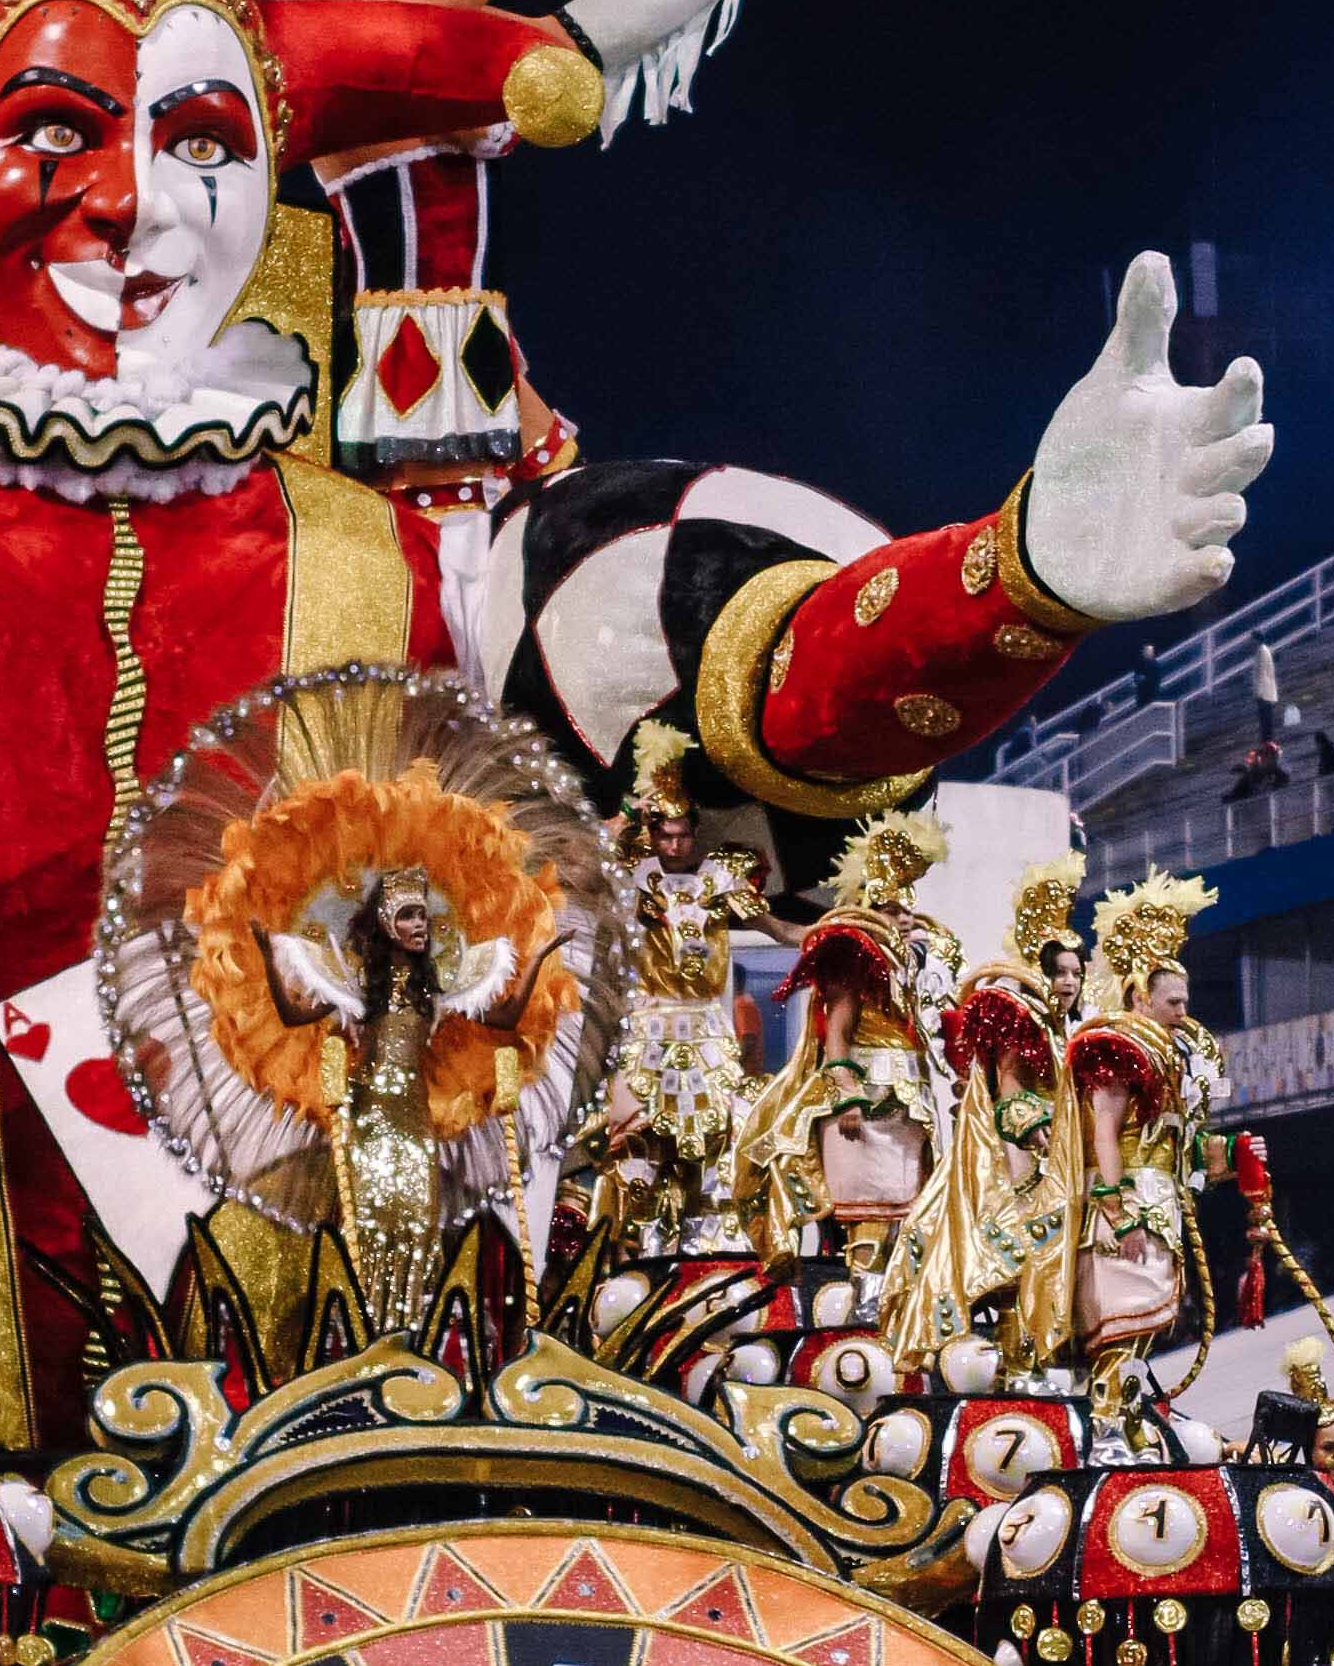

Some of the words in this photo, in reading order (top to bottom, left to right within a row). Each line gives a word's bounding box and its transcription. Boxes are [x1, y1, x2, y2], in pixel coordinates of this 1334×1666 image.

[4, 1002, 32, 1035] A
[835, 1349, 870, 1391] 0
[995, 1430, 1026, 1471] 7
